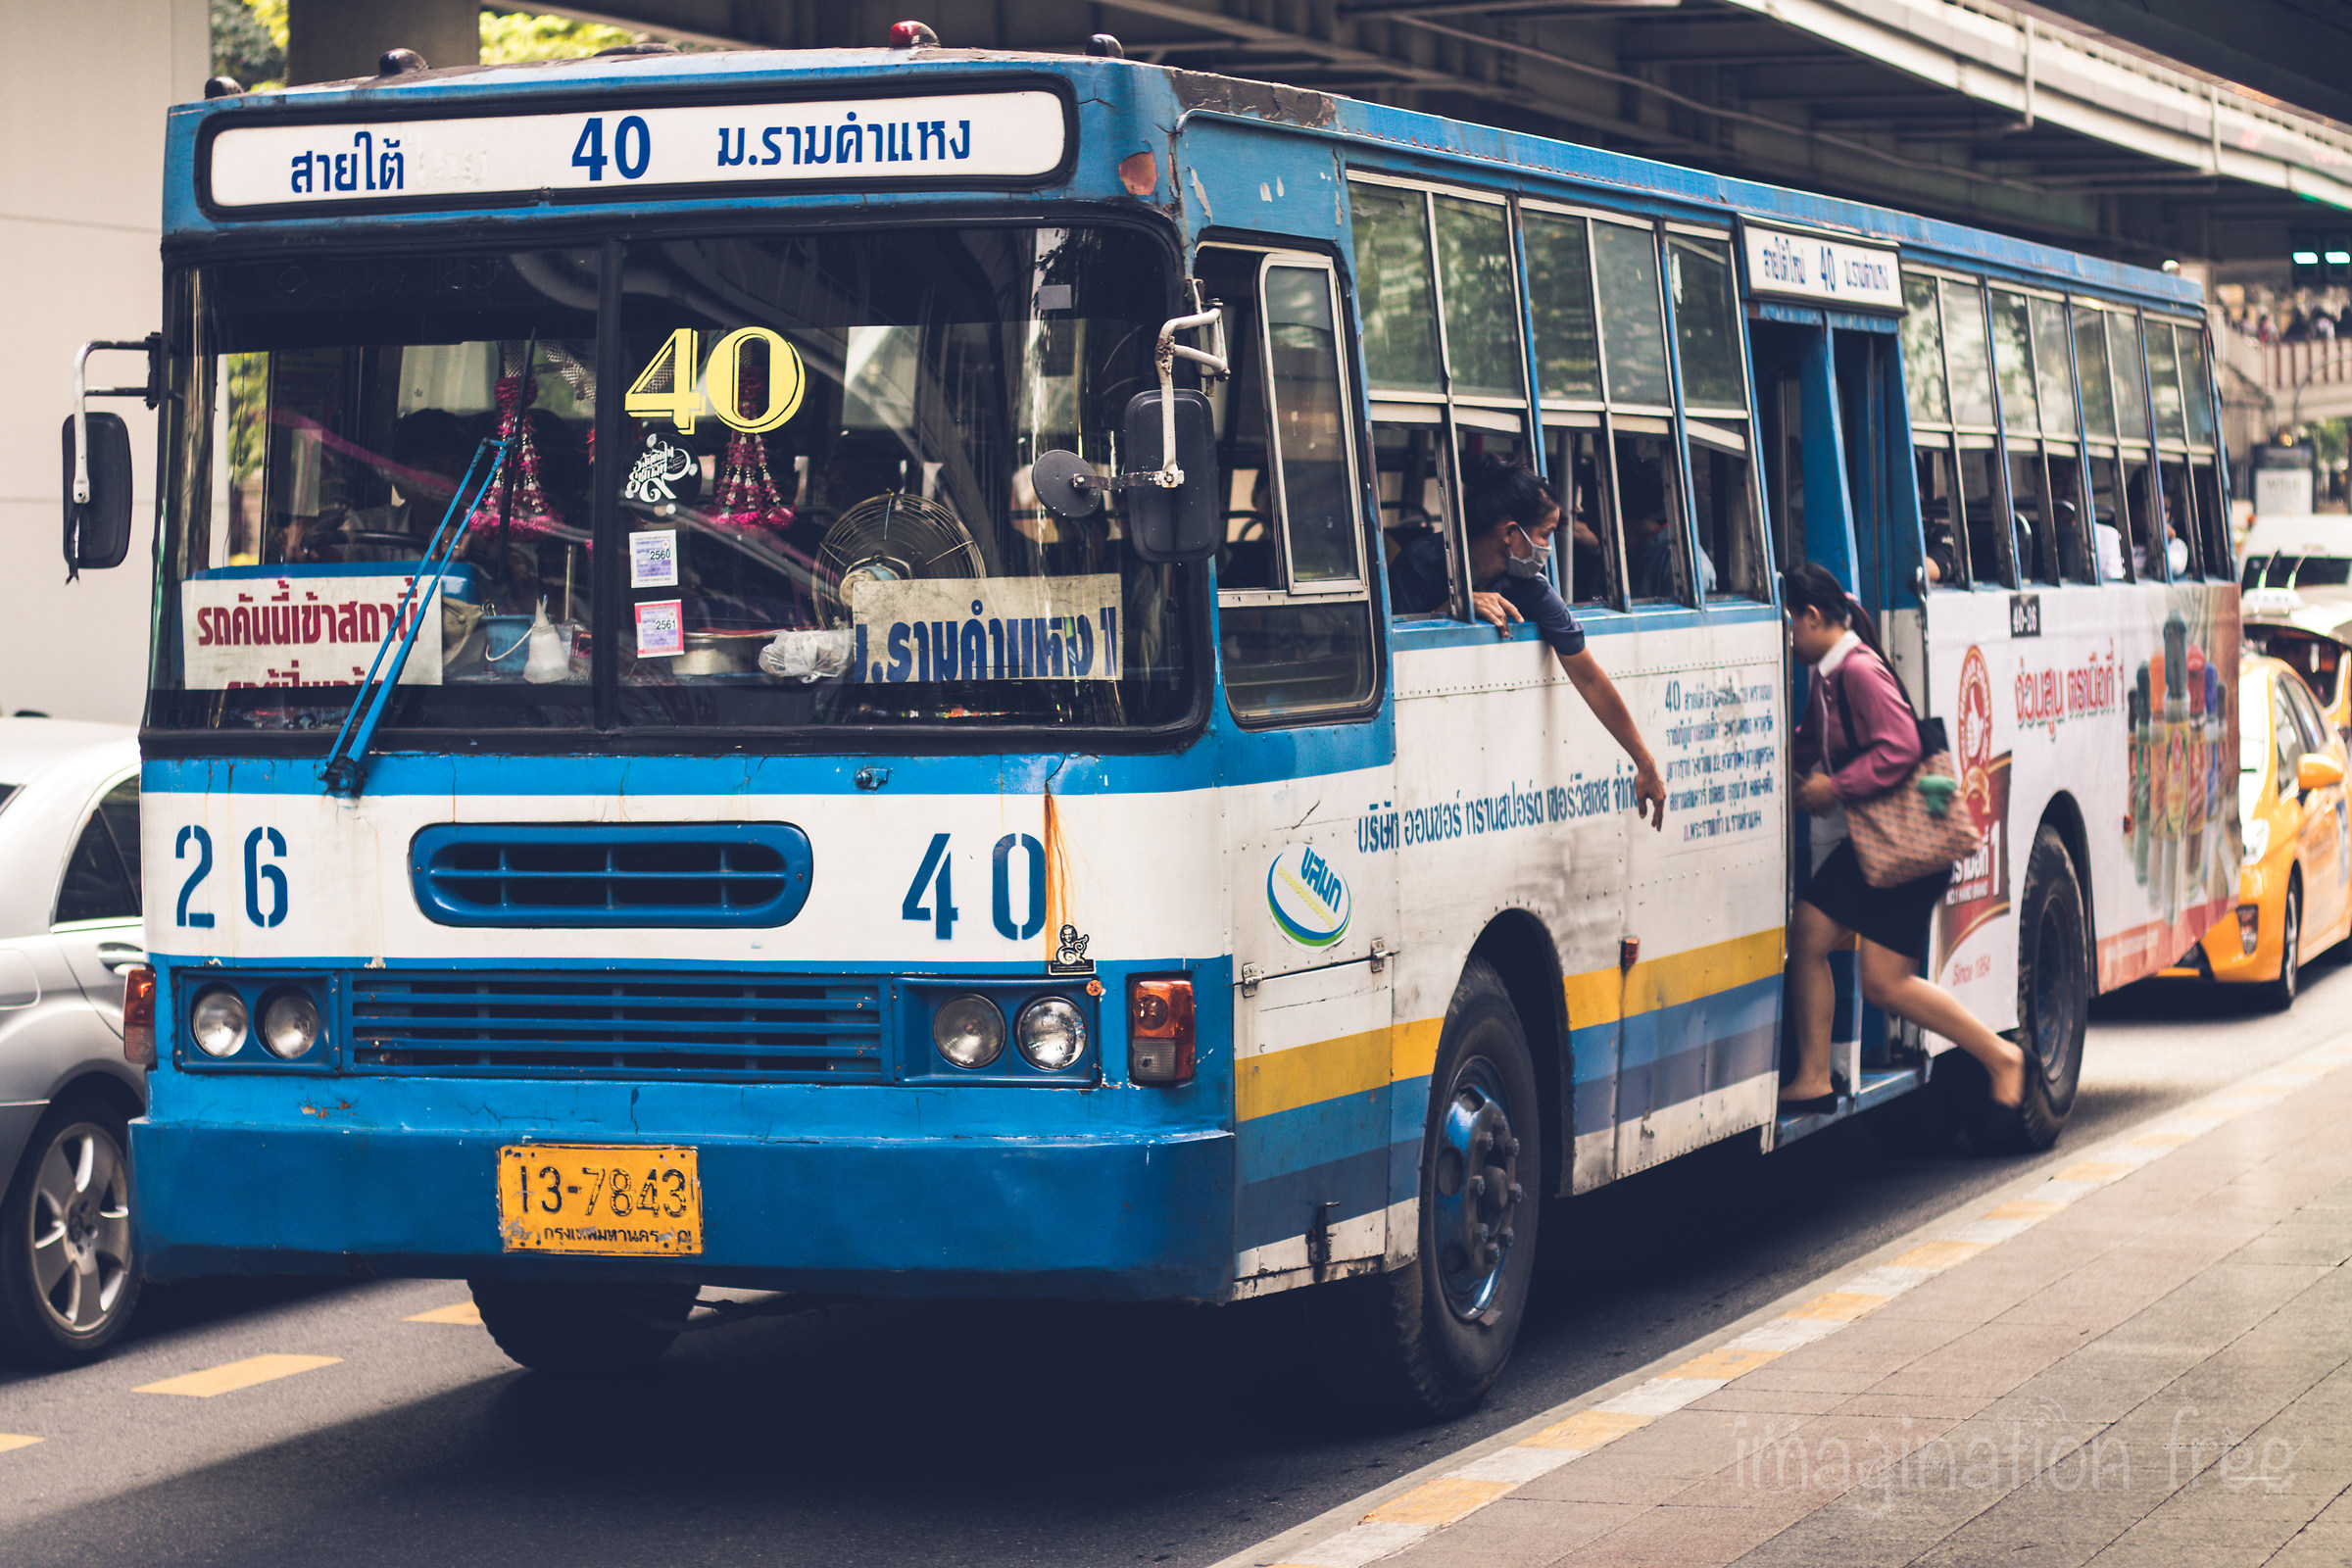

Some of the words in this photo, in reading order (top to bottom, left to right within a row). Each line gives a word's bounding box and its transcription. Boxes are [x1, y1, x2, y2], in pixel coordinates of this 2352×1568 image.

[291, 130, 405, 194] สายใต้
[570, 115, 652, 181] 40
[717, 112, 971, 168] ม.รามคำแหง
[1821, 245, 1836, 292] 40
[624, 326, 806, 434] 40
[650, 549, 671, 561] 2560
[656, 619, 677, 630] 2561
[2012, 605, 2037, 633] 40-26
[1665, 680, 1681, 712] 40
[1358, 800, 1399, 854] บริษัท
[175, 824, 289, 929] 26
[902, 833, 1046, 941] 40
[1300, 846, 1343, 913] ขสมก
[520, 1165, 687, 1217] 13-7843
